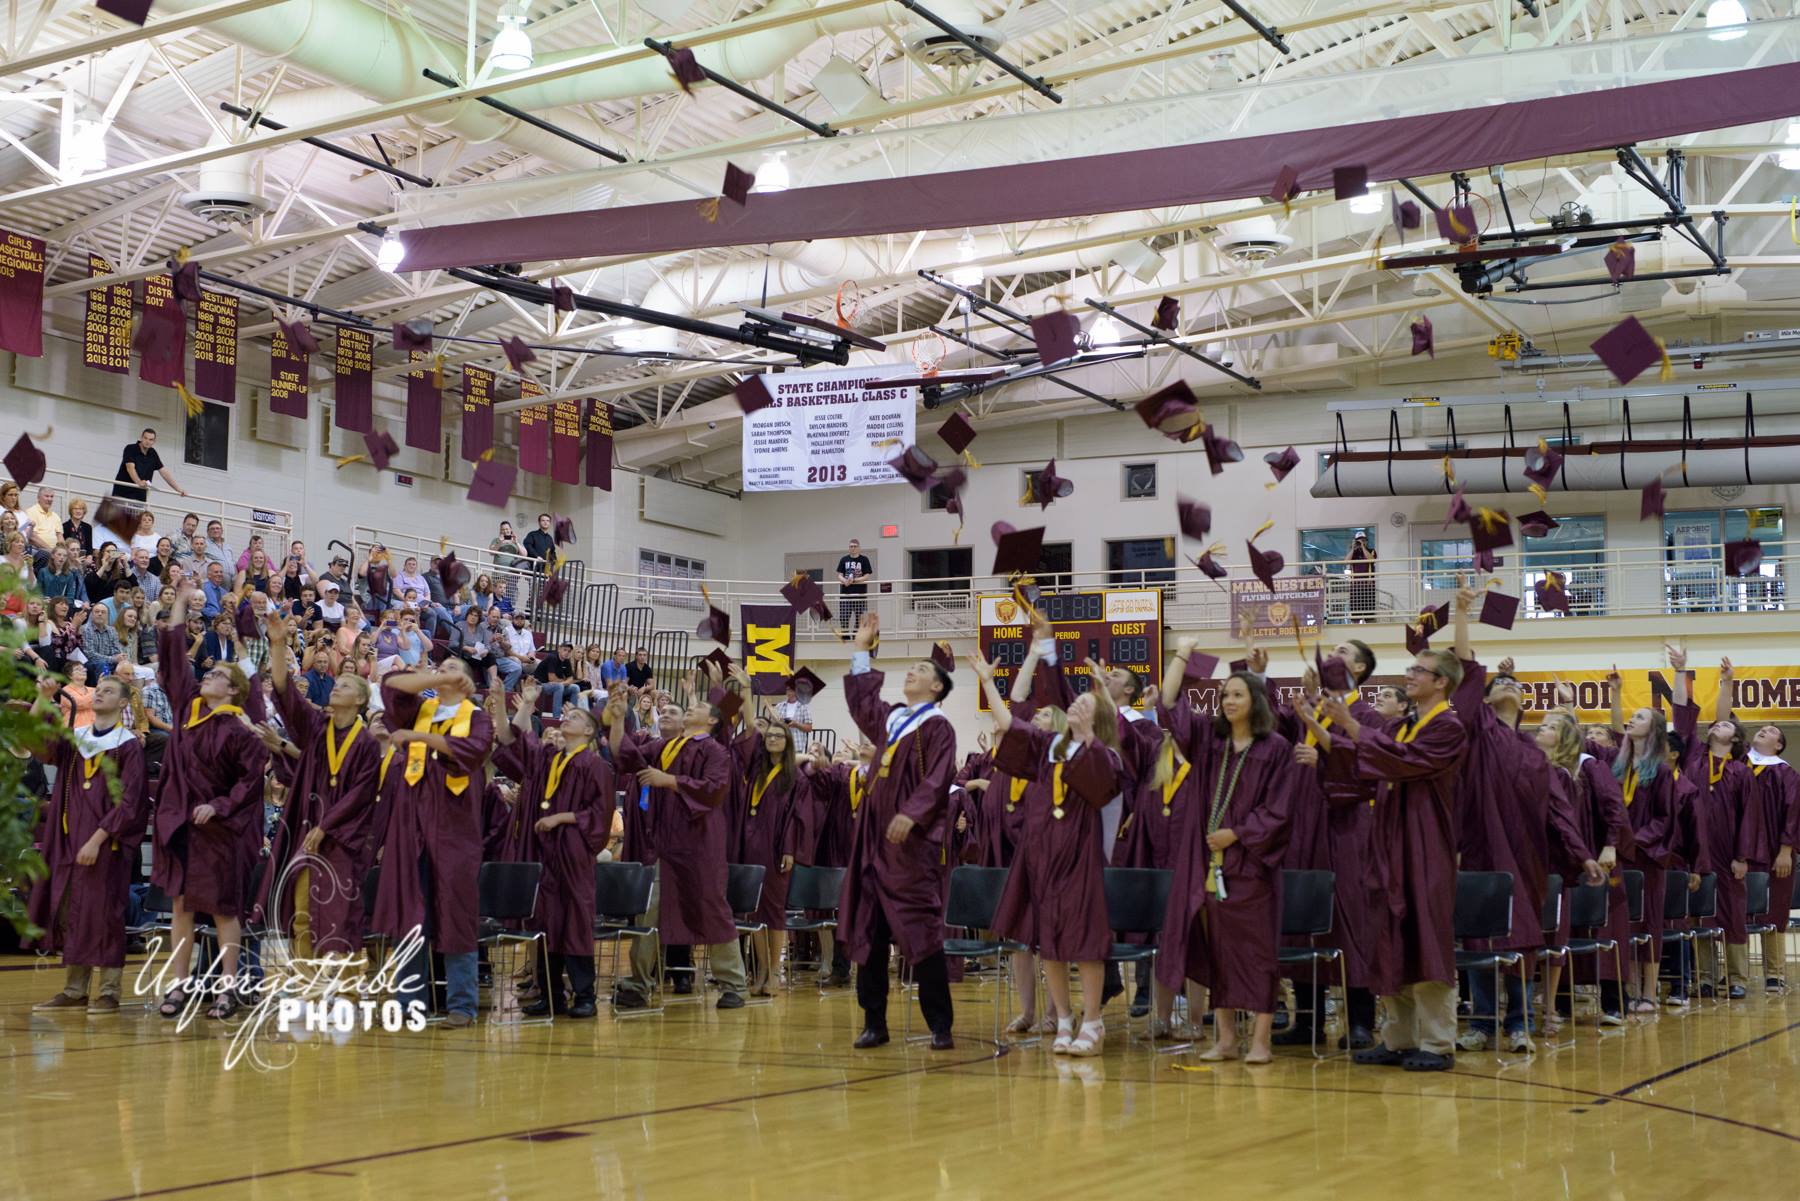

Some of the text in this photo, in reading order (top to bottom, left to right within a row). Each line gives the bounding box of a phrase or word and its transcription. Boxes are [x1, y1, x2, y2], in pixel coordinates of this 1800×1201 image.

[8, 234, 33, 250] GIRLS
[0, 243, 43, 262] ASKETBALL
[145, 295, 164, 307] 2017
[200, 301, 235, 317] REGIONAL
[87, 311, 107, 324] 2007
[86, 332, 104, 344] 2011
[338, 328, 371, 344] SOFTBALL
[86, 343, 107, 355] 2013
[195, 340, 211, 352] 2011
[340, 337, 370, 352] DISTRICT
[86, 353, 108, 365] 2015
[280, 371, 299, 382] STATE
[465, 367, 493, 382] SOFTBALL
[271, 379, 308, 394] RUNNER-UP
[470, 377, 488, 388] STATE
[778, 382, 813, 395] STATE
[471, 386, 486, 396] SEMI
[466, 394, 491, 407] FINALIST
[786, 393, 858, 408] BASKETBALL
[862, 389, 896, 402] CLASS
[900, 388, 908, 399] C
[590, 415, 611, 429] REGIONAL
[808, 464, 847, 483] 2013
[253, 512, 276, 523] VISITORS
[845, 561, 862, 569] USA
[1241, 591, 1320, 602] FLYING DUTCHMEN
[993, 627, 1023, 639] HOME
[1112, 623, 1146, 635] GUEST
[1055, 631, 1081, 640] PERIOD
[746, 624, 794, 676] M
